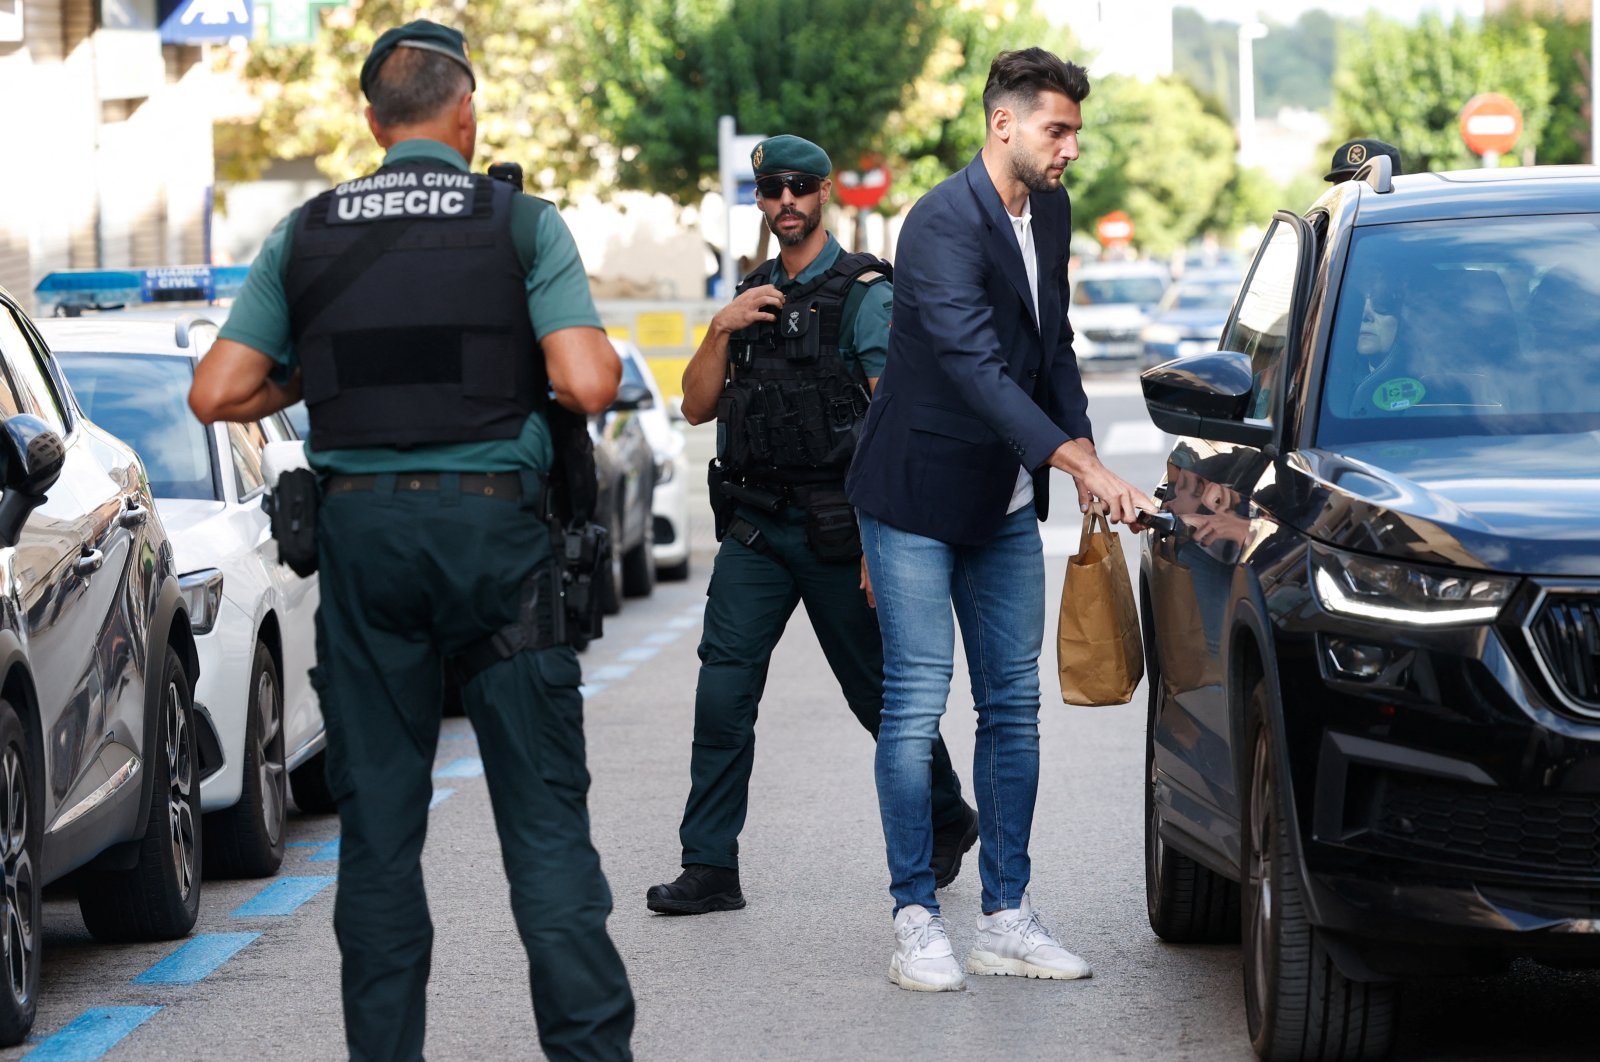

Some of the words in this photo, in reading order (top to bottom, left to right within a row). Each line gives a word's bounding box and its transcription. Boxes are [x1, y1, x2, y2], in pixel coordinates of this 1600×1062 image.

[335, 172, 417, 196] GUARDIA
[422, 172, 474, 189] CIVIL
[337, 190, 465, 220] USECIC
[158, 277, 198, 289] CIVIL
